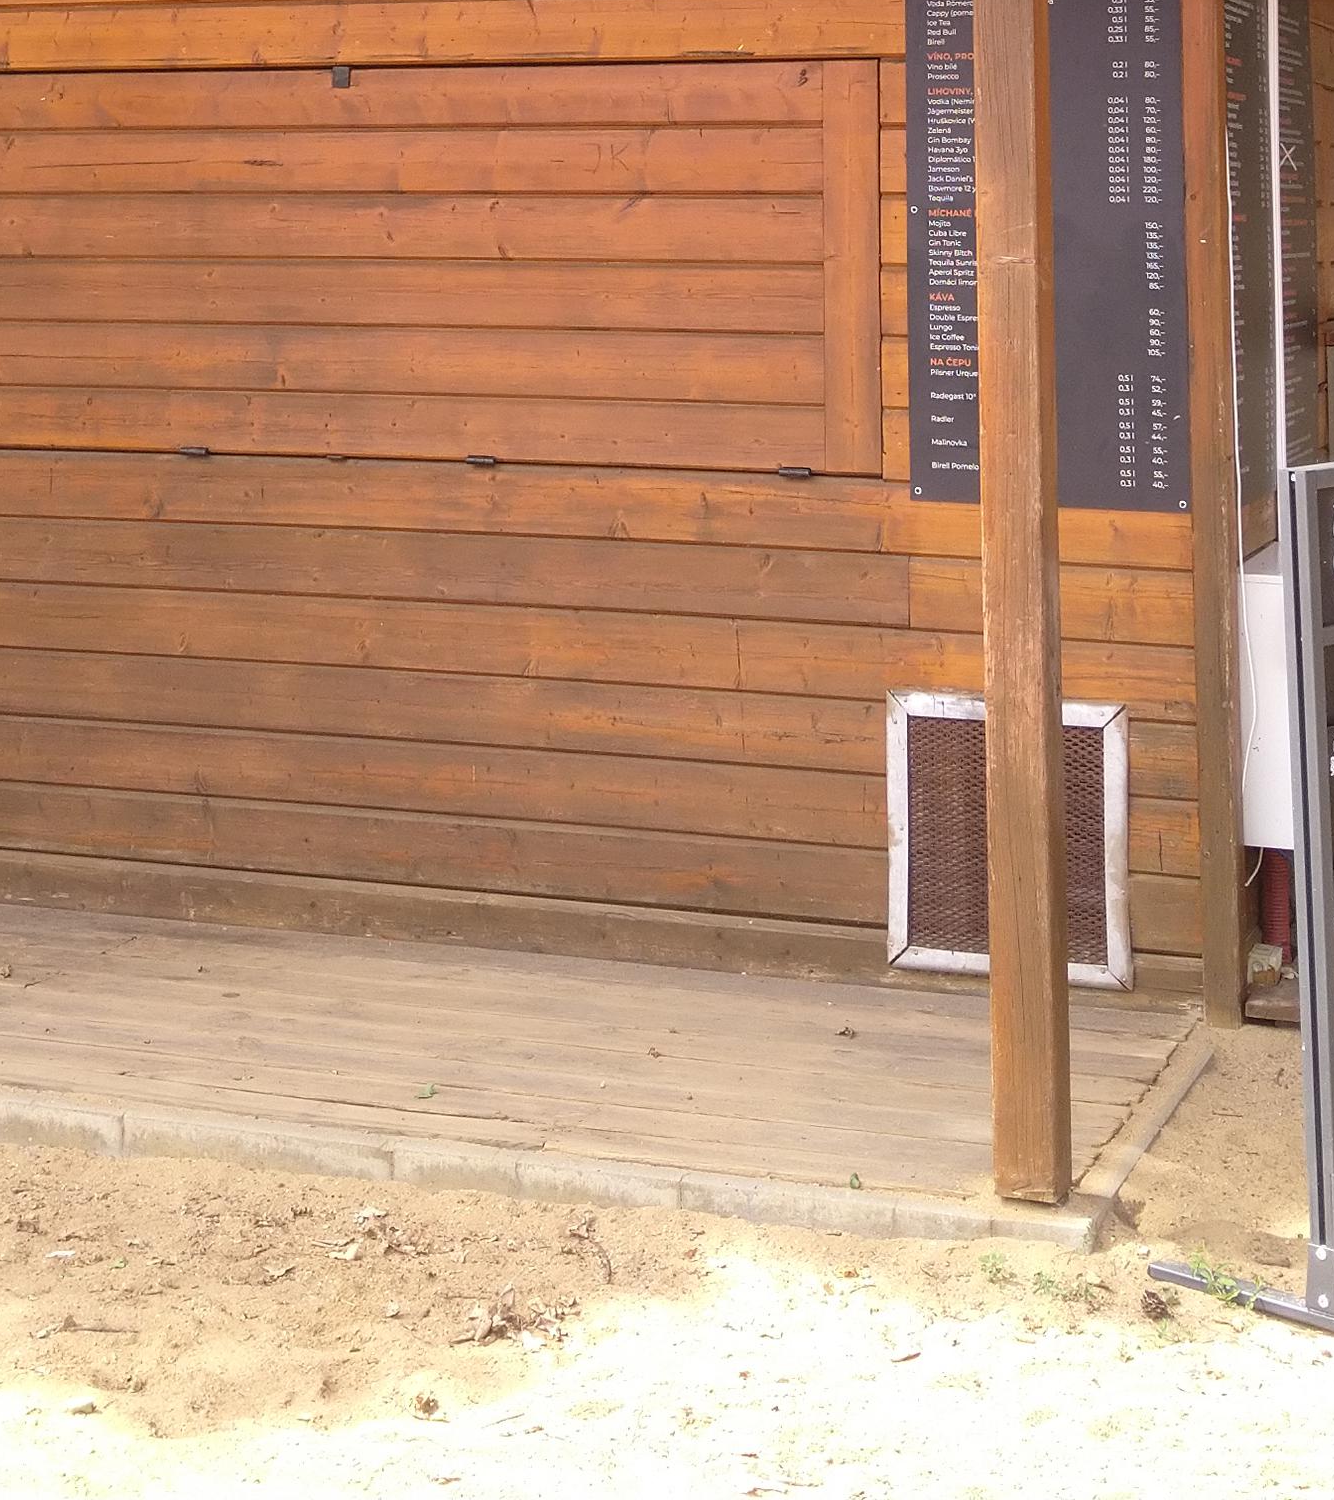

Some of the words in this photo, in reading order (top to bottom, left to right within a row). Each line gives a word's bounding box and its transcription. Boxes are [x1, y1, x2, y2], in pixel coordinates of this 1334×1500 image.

[1146, 35, 1159, 43] 55,-
[927, 52, 953, 61] VÍNO,
[955, 146, 968, 154] 3yo
[964, 185, 972, 193] 12
[929, 208, 971, 217] MÍCHANÉ
[929, 220, 951, 228] Mojito
[929, 249, 952, 257] Skinny
[929, 259, 954, 267] Tequila
[1146, 272, 1163, 280] 120,-
[929, 292, 954, 301] KÁVA
[957, 315, 978, 323] Espre
[930, 324, 952, 332] Lungo
[930, 343, 961, 351] Espresso
[946, 357, 971, 367] ČEPU
[956, 369, 978, 378] Urque
[1151, 375, 1166, 383] 74,-
[931, 392, 964, 401] Radegast
[1152, 399, 1166, 407] 59,-
[1153, 423, 1167, 431] 57,-
[1153, 447, 1167, 455] 55,-
[1152, 457, 1167, 465] 40,-
[951, 462, 979, 470] Pomelo
[1154, 471, 1168, 479] 55,-
[1152, 481, 1168, 489] 40,-
